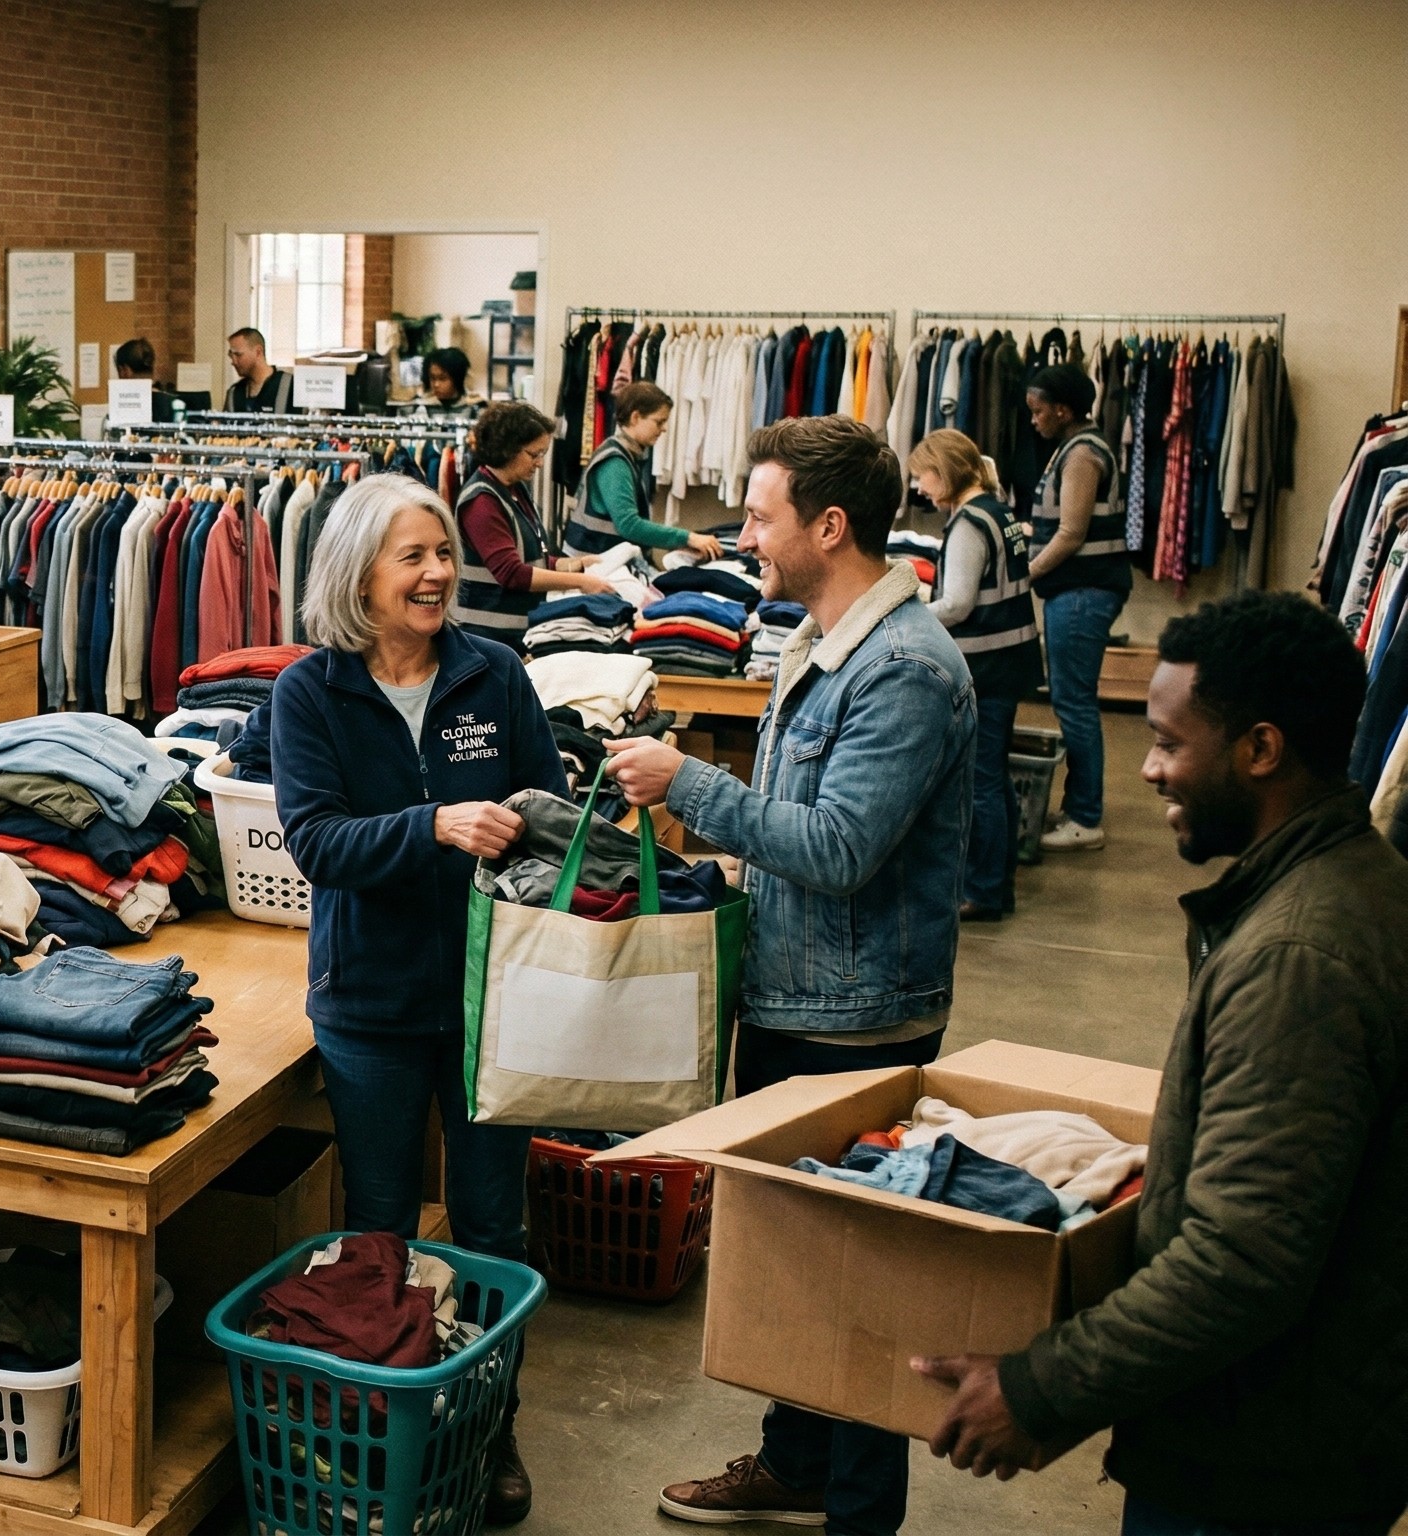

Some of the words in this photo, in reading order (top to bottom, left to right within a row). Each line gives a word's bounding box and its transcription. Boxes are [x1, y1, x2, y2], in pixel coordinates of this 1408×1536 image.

[456, 713, 476, 725] THE
[441, 722, 497, 740] CLOTHING
[455, 736, 488, 751] BANK
